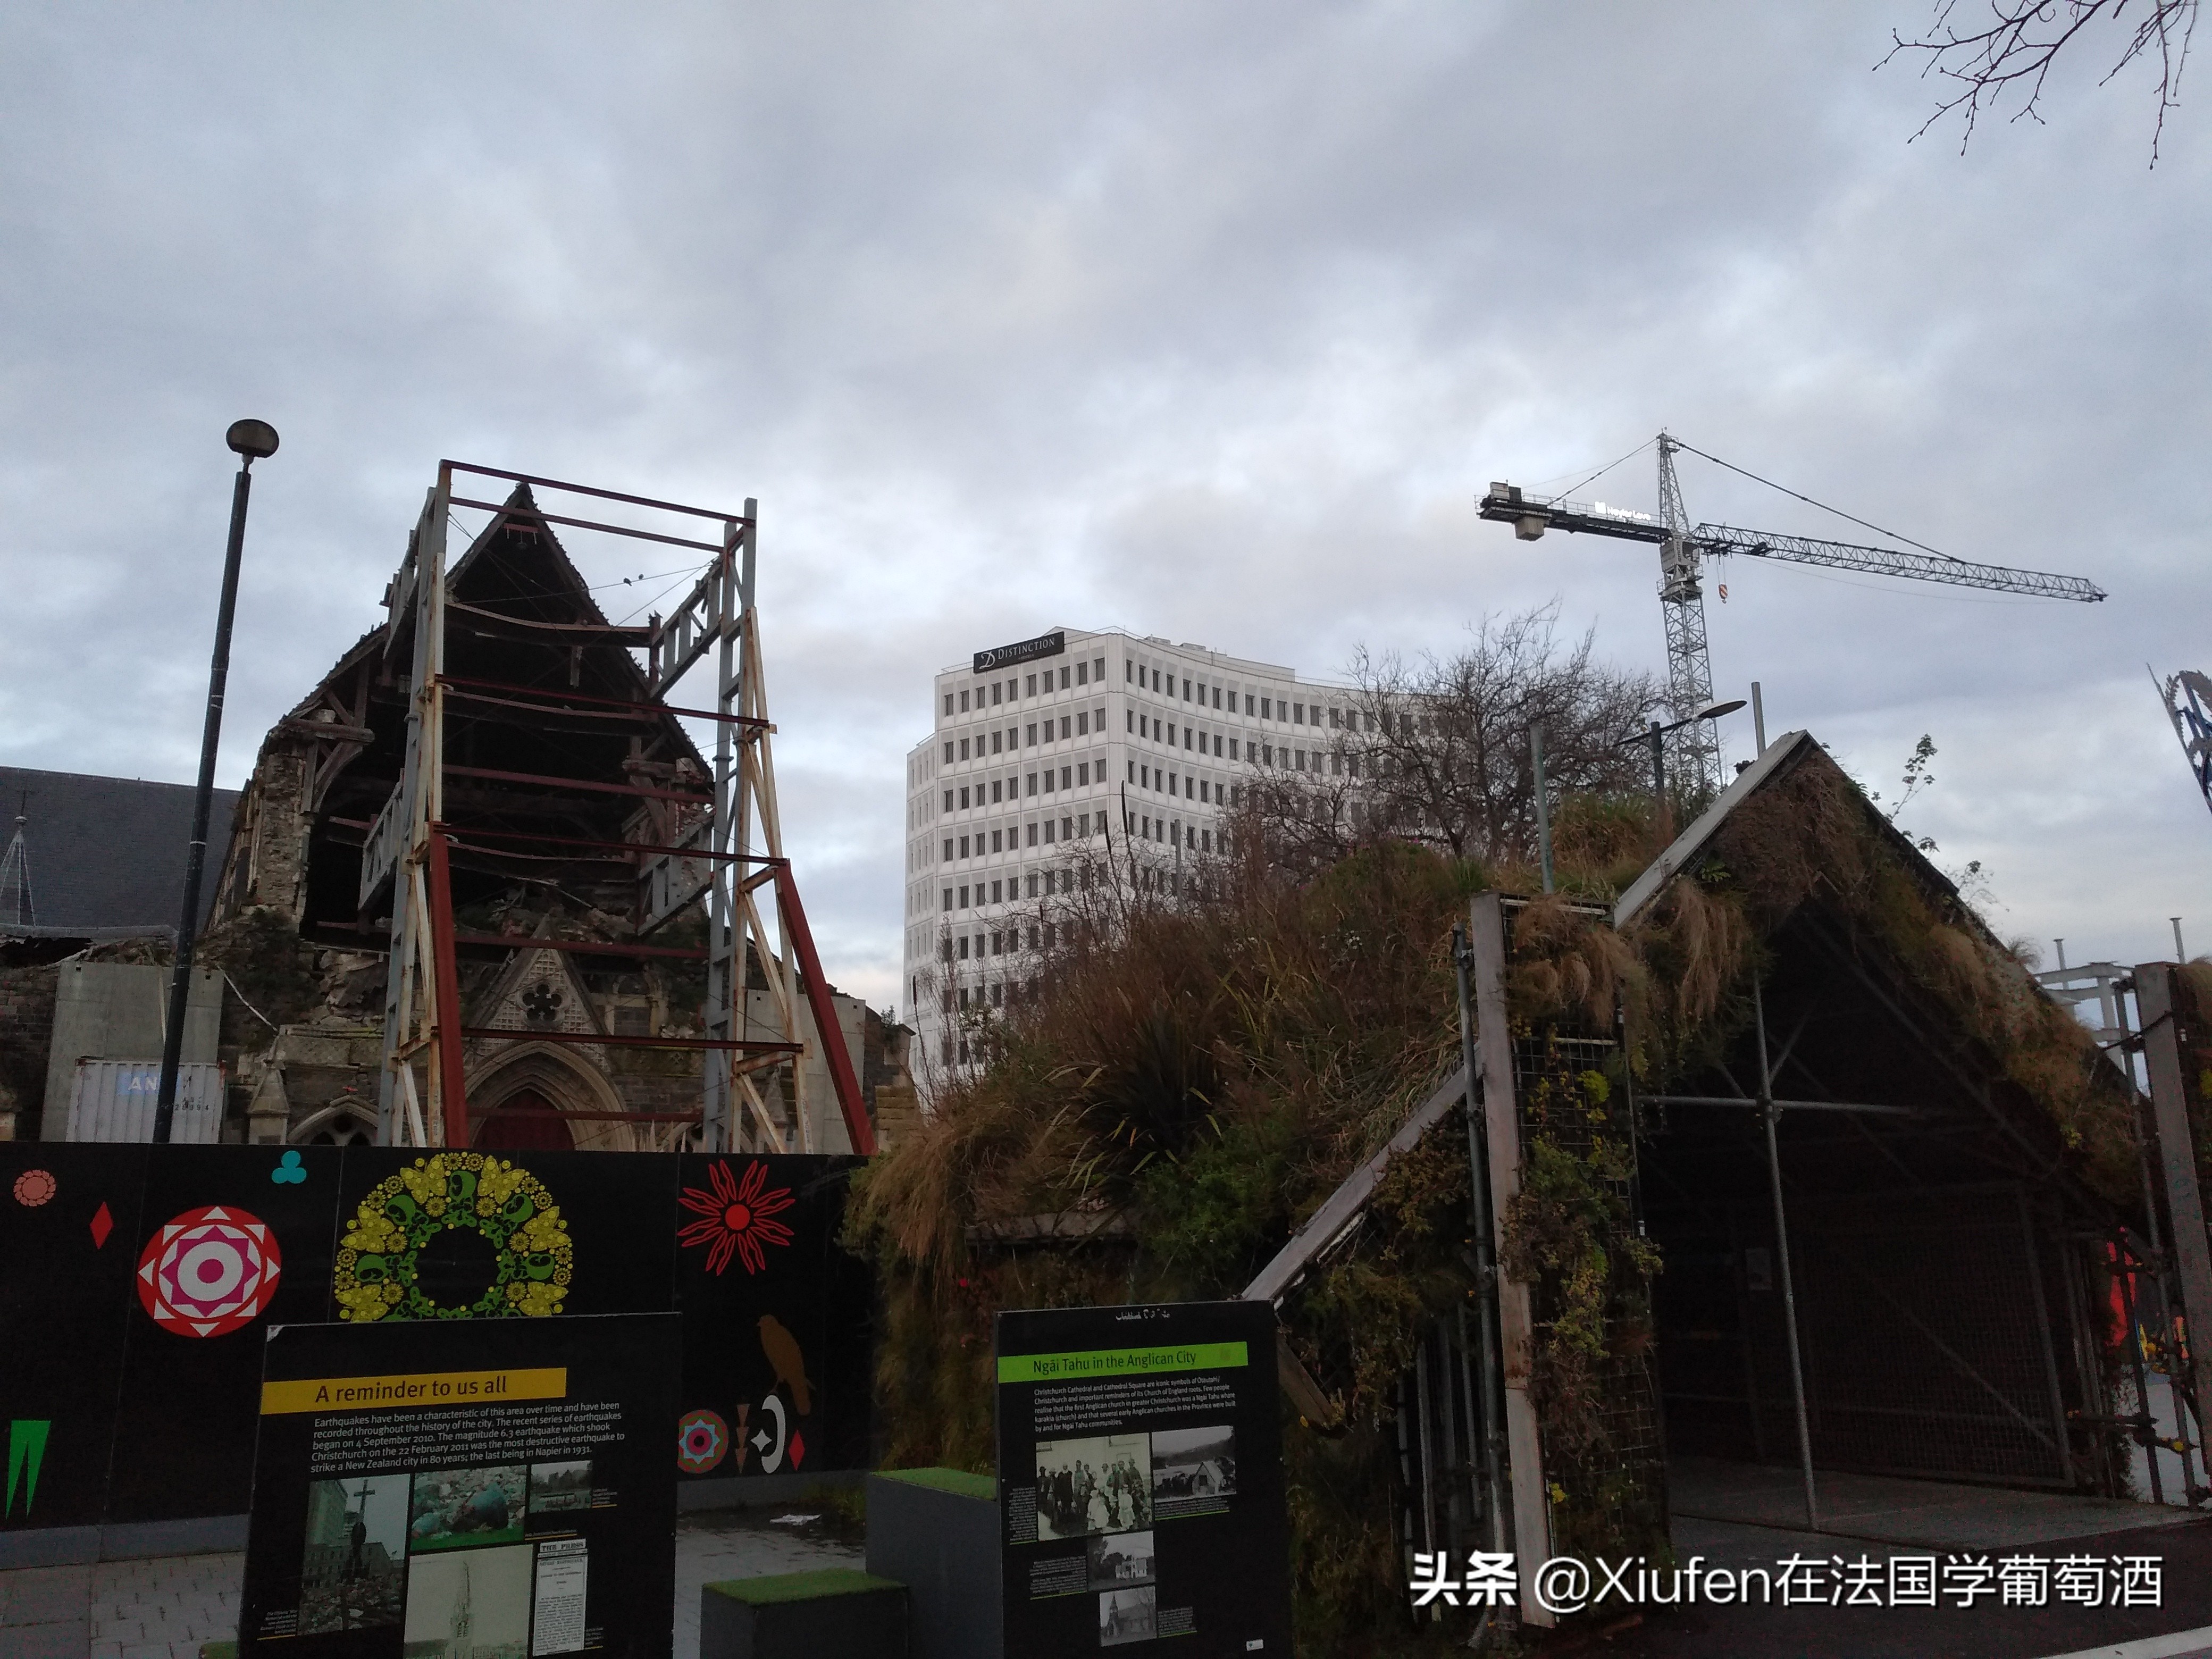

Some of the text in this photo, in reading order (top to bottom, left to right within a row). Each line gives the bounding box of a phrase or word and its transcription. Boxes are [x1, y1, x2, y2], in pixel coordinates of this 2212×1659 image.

[998, 638, 1055, 659] DISTINCTION
[1033, 1350, 1196, 1376] Ngāi Tahu in the Anglican City
[315, 1376, 506, 1403] A reminder to us all
[1034, 1387, 1067, 1396] Christchurch
[1067, 1385, 1092, 1393] Cathedral
[1103, 1382, 1128, 1390] Cathedral
[1034, 1396, 1067, 1405] Christchurch
[1078, 1394, 1104, 1402] important
[314, 1415, 370, 1427] Earthquakes
[371, 1414, 392, 1423] have
[393, 1413, 415, 1422] been
[424, 1409, 479, 1420] characteristic
[480, 1407, 489, 1417] of
[490, 1407, 505, 1417] this
[544, 1404, 563, 1413] time
[564, 1403, 579, 1412] and
[580, 1402, 599, 1411] have
[1085, 1402, 1107, 1411] Anglican
[1150, 1396, 1181, 1405] Christchurch
[313, 1411, 622, 1438] recorded throughout the history of the city. The recent series of earthquakes
[1055, 1413, 1076, 1422] (church)
[312, 1448, 367, 1461] Christchurch
[382, 1447, 397, 1456] the
[411, 1444, 449, 1454] February
[489, 1439, 502, 1448] the
[525, 1435, 570, 1446] destructive
[571, 1432, 615, 1443] earthquake
[313, 1440, 340, 1451] began
[355, 1440, 362, 1448] 4
[363, 1435, 412, 1447] September
[438, 1432, 453, 1441] The
[455, 1429, 499, 1441] magnitude
[500, 1428, 514, 1438] 6.3
[515, 1425, 561, 1436] earthquake
[562, 1423, 585, 1433] which
[586, 1422, 610, 1432] shook
[311, 1462, 336, 1473] strike
[345, 1461, 365, 1470] New
[366, 1457, 401, 1469] Zealand
[403, 1456, 418, 1467] city
[420, 1455, 428, 1464] in
[430, 1455, 441, 1464] 80
[442, 1454, 468, 1464] years;
[470, 1452, 483, 1461] the
[485, 1451, 500, 1460] last
[501, 1449, 525, 1459] being
[535, 1446, 562, 1457] Napier
[572, 1446, 592, 1455] 1931.
